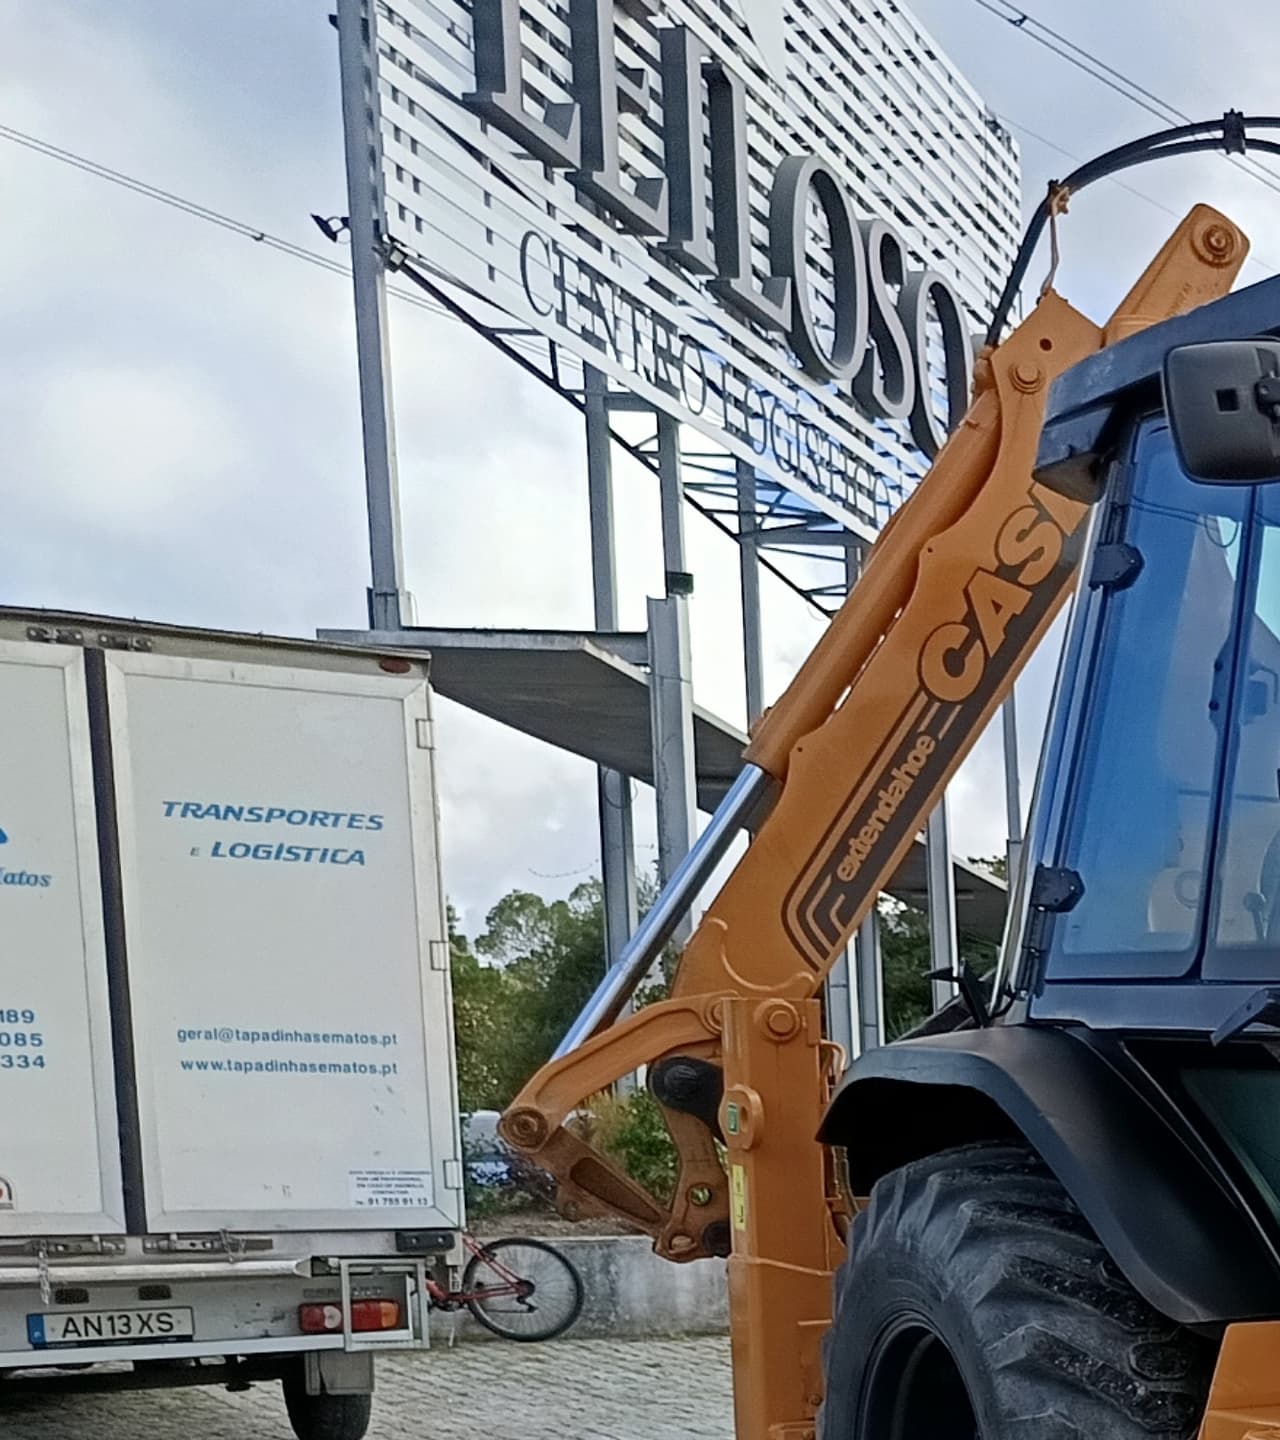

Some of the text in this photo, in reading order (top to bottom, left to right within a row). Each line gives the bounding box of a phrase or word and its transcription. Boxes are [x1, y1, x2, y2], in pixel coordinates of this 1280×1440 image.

[520, 230, 707, 415] CENTRO
[162, 801, 385, 831] TRANSPORTES
[838, 733, 936, 882] extendahoe
[0, 867, 51, 888] atos
[177, 1027, 398, 1047] geral@tapadinhasematos.pt
[1, 1054, 46, 1069] 334
[181, 1059, 398, 1075] www.tapadinhasematos.pt
